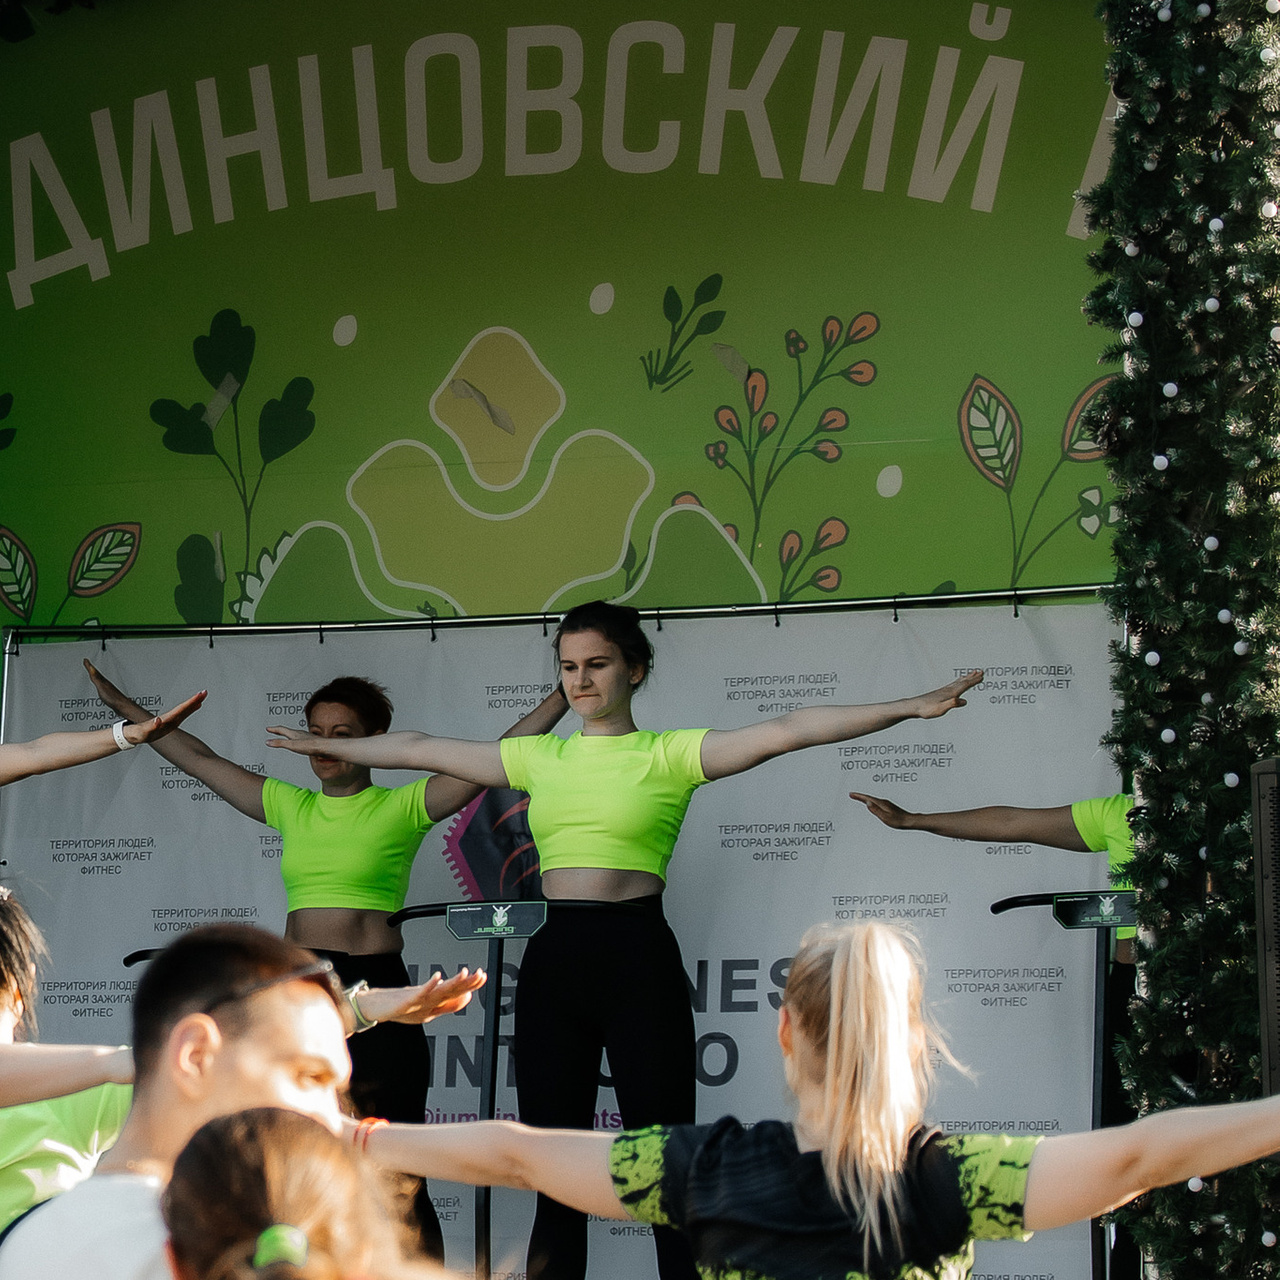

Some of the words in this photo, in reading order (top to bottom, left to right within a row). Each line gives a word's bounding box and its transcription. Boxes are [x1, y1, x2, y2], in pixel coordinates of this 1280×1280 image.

[723, 675, 795, 688] ТЕРРИТОРИЯ
[1010, 679, 1072, 691] ЗАЖИГАЕТ
[484, 683, 553, 696] ТЕРРИТОРИЯ
[726, 689, 776, 701] КОТОРАЯ
[778, 687, 837, 699] ЗАЖИГАЕТ
[265, 691, 313, 702] ТЕРРИТО
[989, 694, 1037, 705] ФИТНЕС
[58, 698, 106, 709] ТЕРРИТО
[487, 697, 536, 709] КОТОРАЯ
[61, 711, 106, 722] КОТОРАЯ
[837, 745, 910, 757] ТЕРРИТОРИЯ
[840, 759, 891, 770] КОТОРАЯ
[893, 757, 953, 769] ЗАЖИГАЕТ
[872, 772, 918, 783] ФИТНЕС
[161, 779, 205, 790] КОТОРА
[718, 823, 790, 835] ТЕРРИТОРИЯ
[49, 838, 115, 850] ТЕРРИТОРИЯ
[720, 837, 771, 849] КОТОРАЯ
[774, 835, 832, 847] ЗАЖИГАЕТ
[985, 844, 1032, 855] ФИТНЕС
[52, 852, 98, 863] КОТОРАЯ
[99, 851, 153, 862] ЗАЖИГАЕТ
[752, 850, 799, 861] ФИТНЕС
[80, 865, 123, 875] ФИТНЕС
[832, 894, 905, 906] ТЕРРИТОРИЯ
[151, 908, 219, 919] ТЕРРИТОРИЯ
[888, 907, 948, 919] ЗАЖИГАЕТ
[944, 968, 1020, 979] ТЕРРИТОРИЯ
[41, 980, 107, 992] ТЕРРИТОРИЯ
[947, 982, 1000, 993] КОТОРАЯ
[1002, 982, 1063, 993] ЗАЖИГАЕТ
[43, 994, 89, 1005] КОТОРАЯ
[980, 996, 1028, 1007] ФИТНЕС
[72, 1007, 114, 1018] ФИТНЕС
[940, 1120, 1015, 1132] ТЕРРИТОРИЯ
